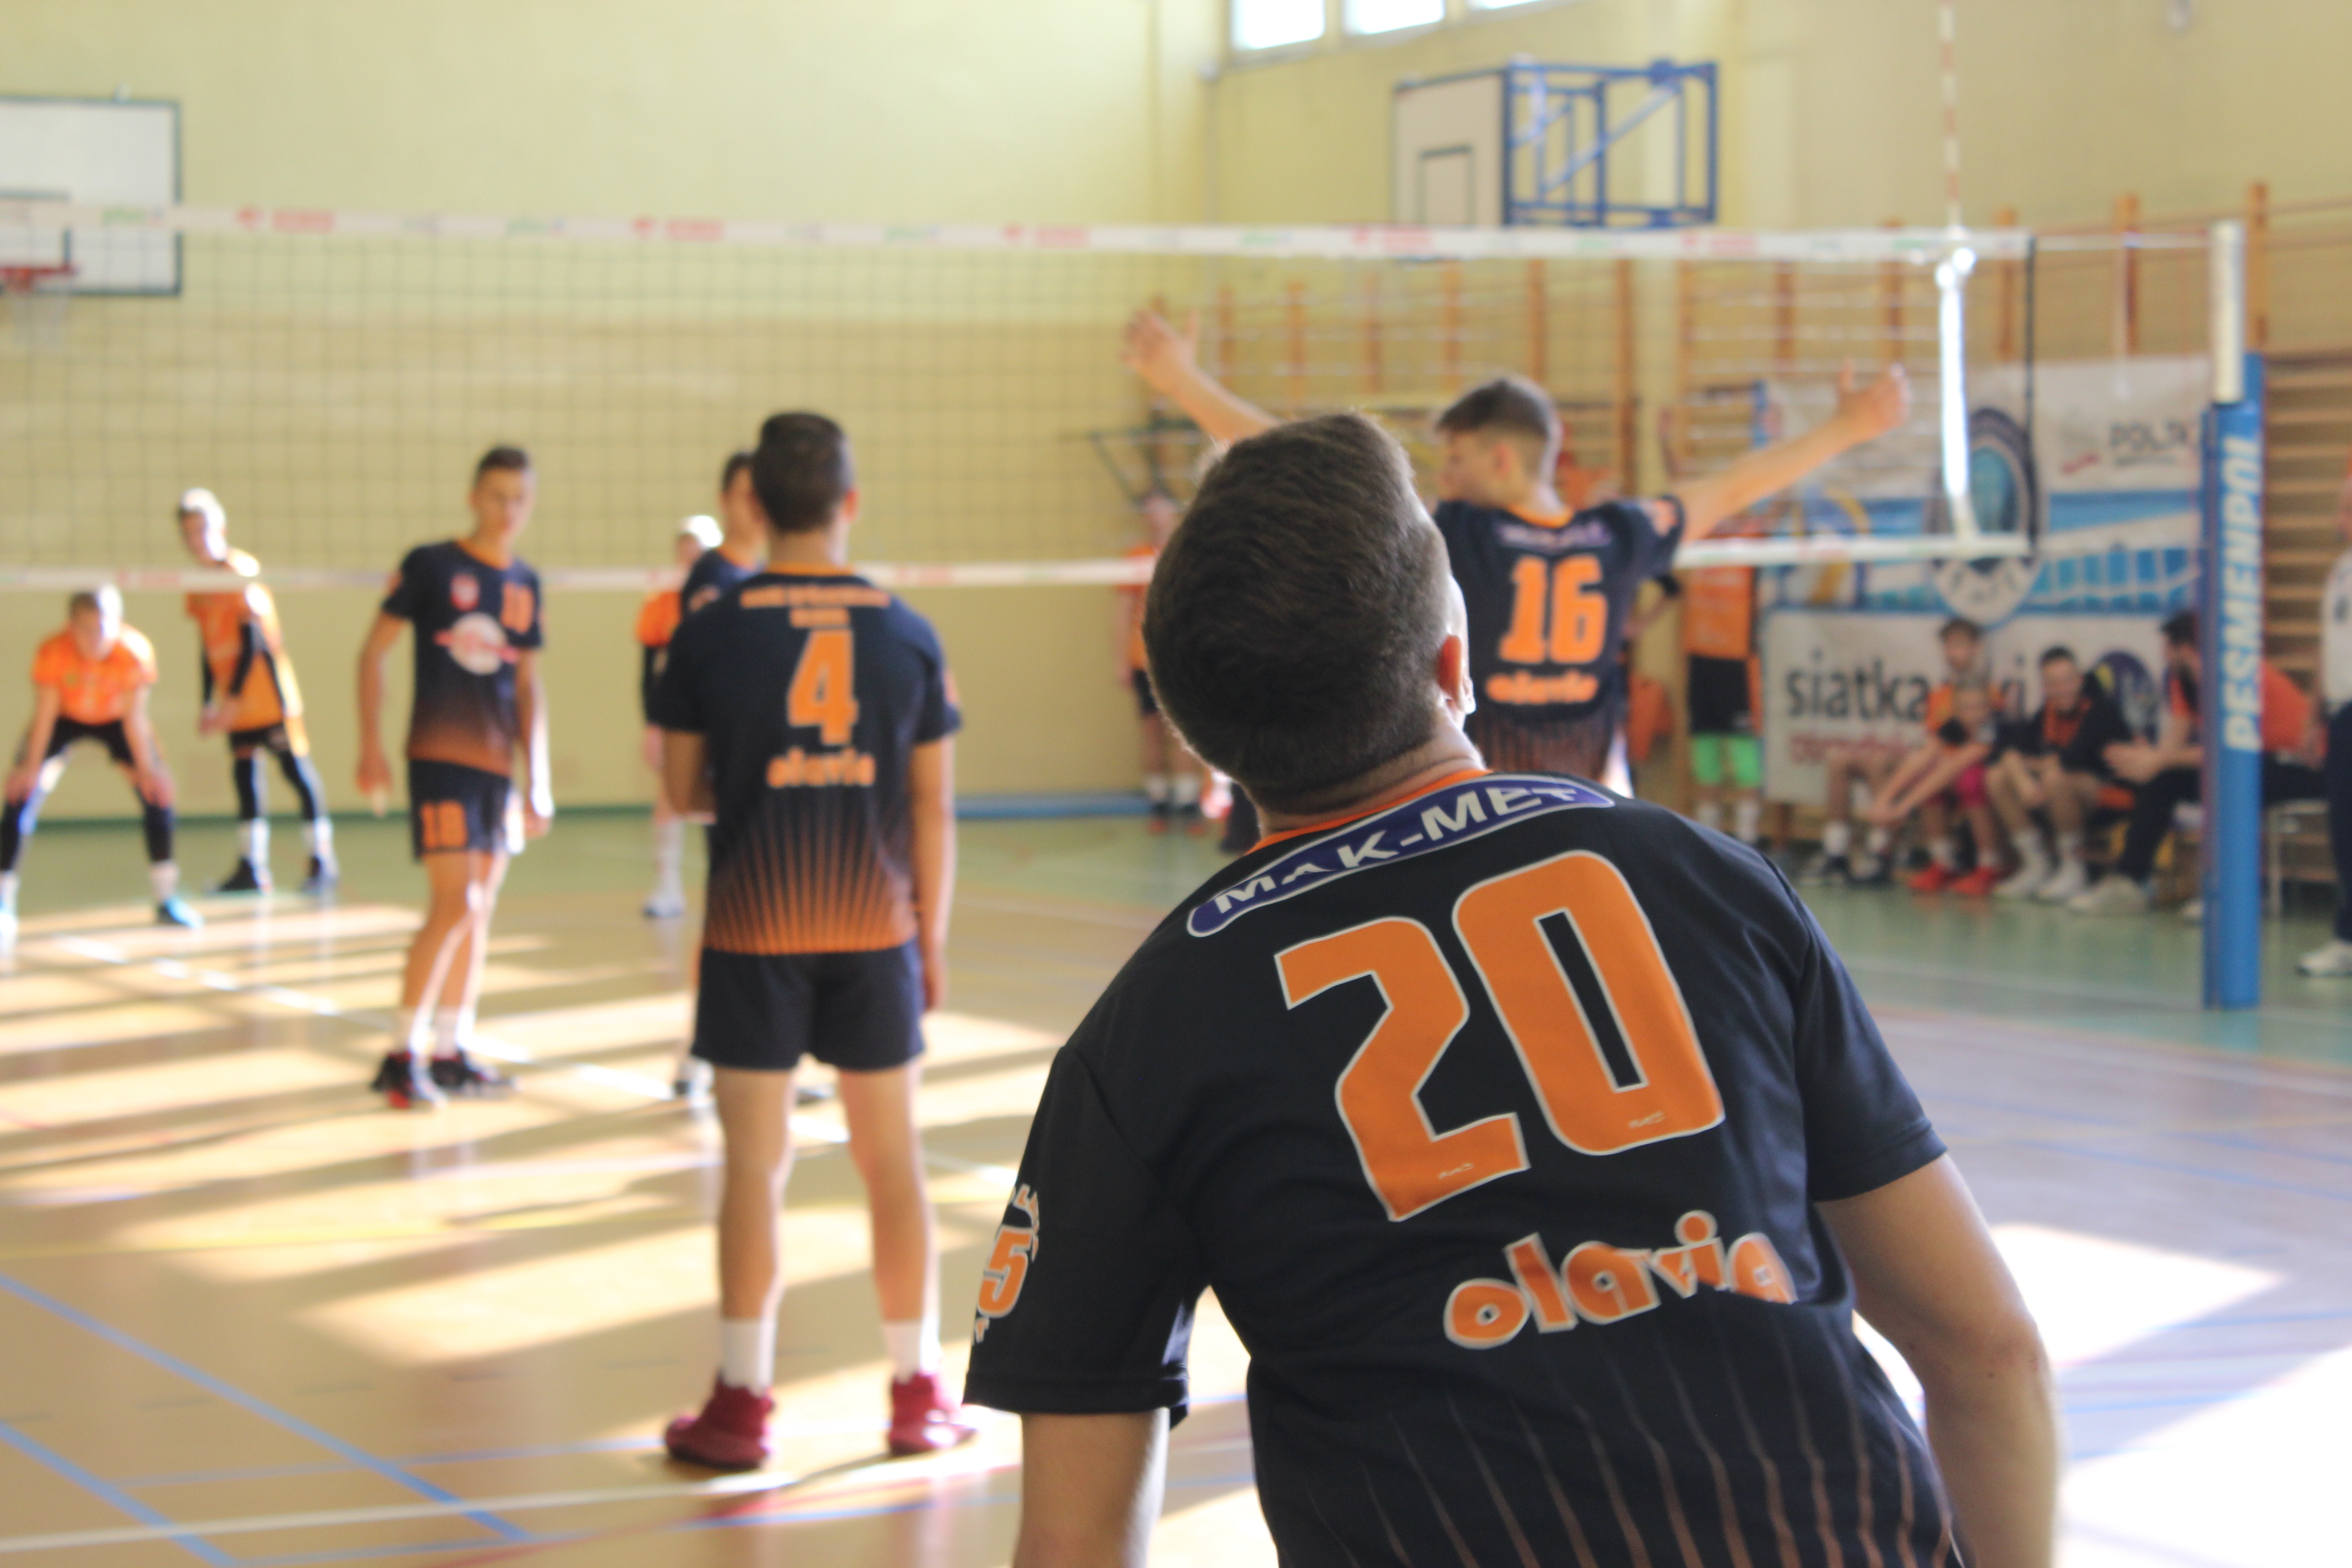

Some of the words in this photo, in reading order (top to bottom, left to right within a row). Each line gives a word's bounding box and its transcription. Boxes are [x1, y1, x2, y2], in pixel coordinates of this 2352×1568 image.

[1499, 554, 1607, 663] 16
[788, 628, 858, 745] 4
[1273, 849, 1725, 1221] 20
[1443, 1209, 1800, 1350] olavia
